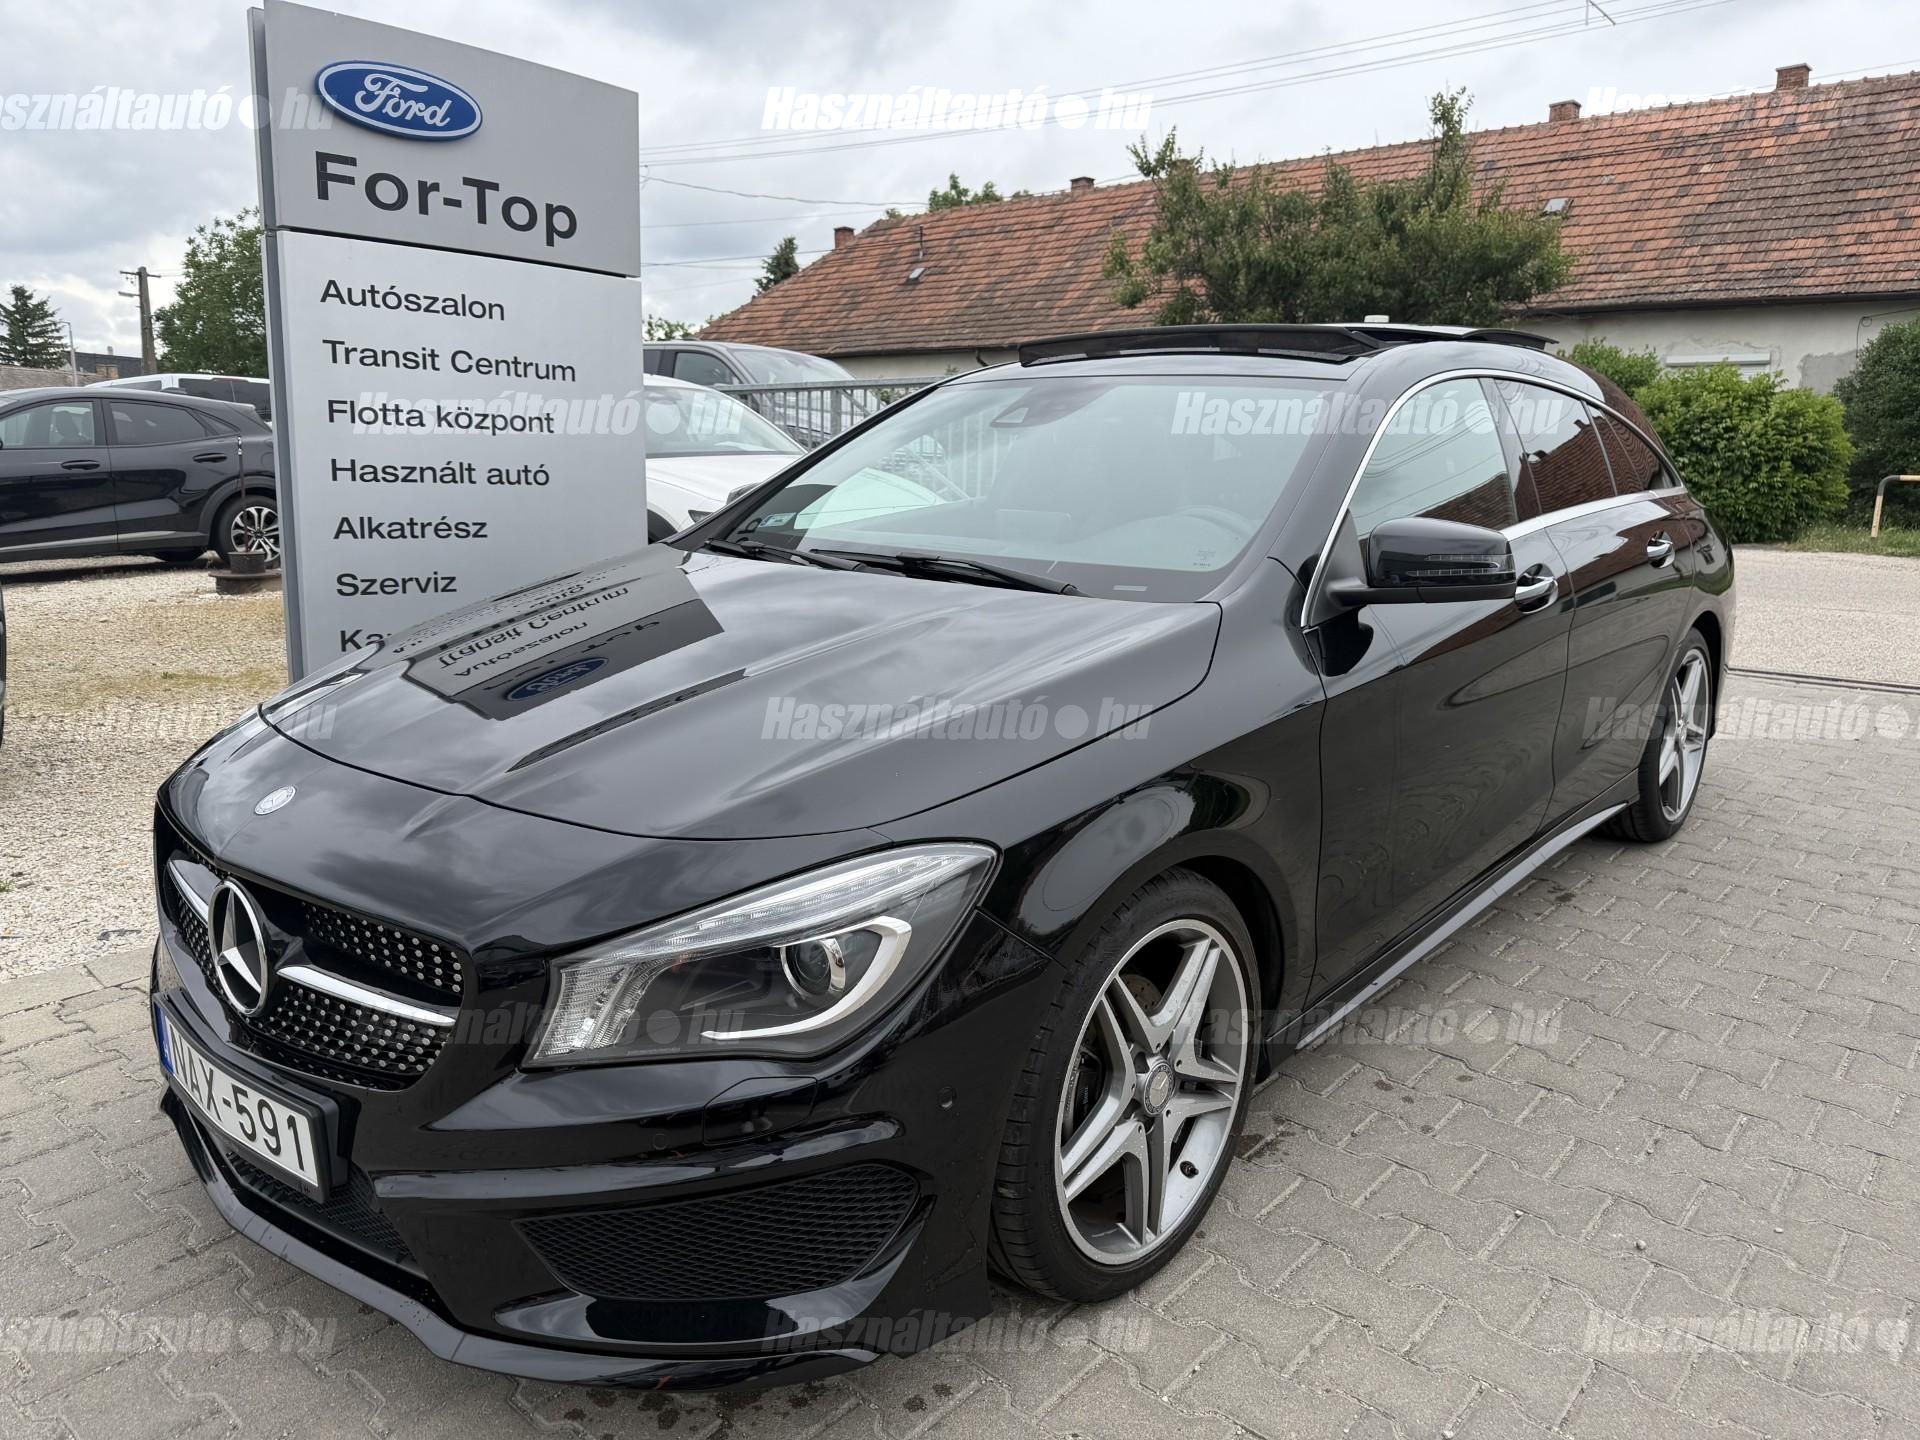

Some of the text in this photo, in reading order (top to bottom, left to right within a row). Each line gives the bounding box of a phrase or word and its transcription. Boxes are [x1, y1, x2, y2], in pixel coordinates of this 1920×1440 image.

[355, 73, 451, 127] Ford
[315, 151, 577, 247] For-Top
[320, 280, 505, 321] Autószalon
[322, 339, 576, 382] Transit Centrum
[328, 399, 555, 436] Flotta központ
[331, 459, 550, 487] Használt autó
[333, 516, 488, 540] Alkatrész
[336, 571, 457, 597] Szerviz
[170, 1023, 305, 1172] NAX-591
